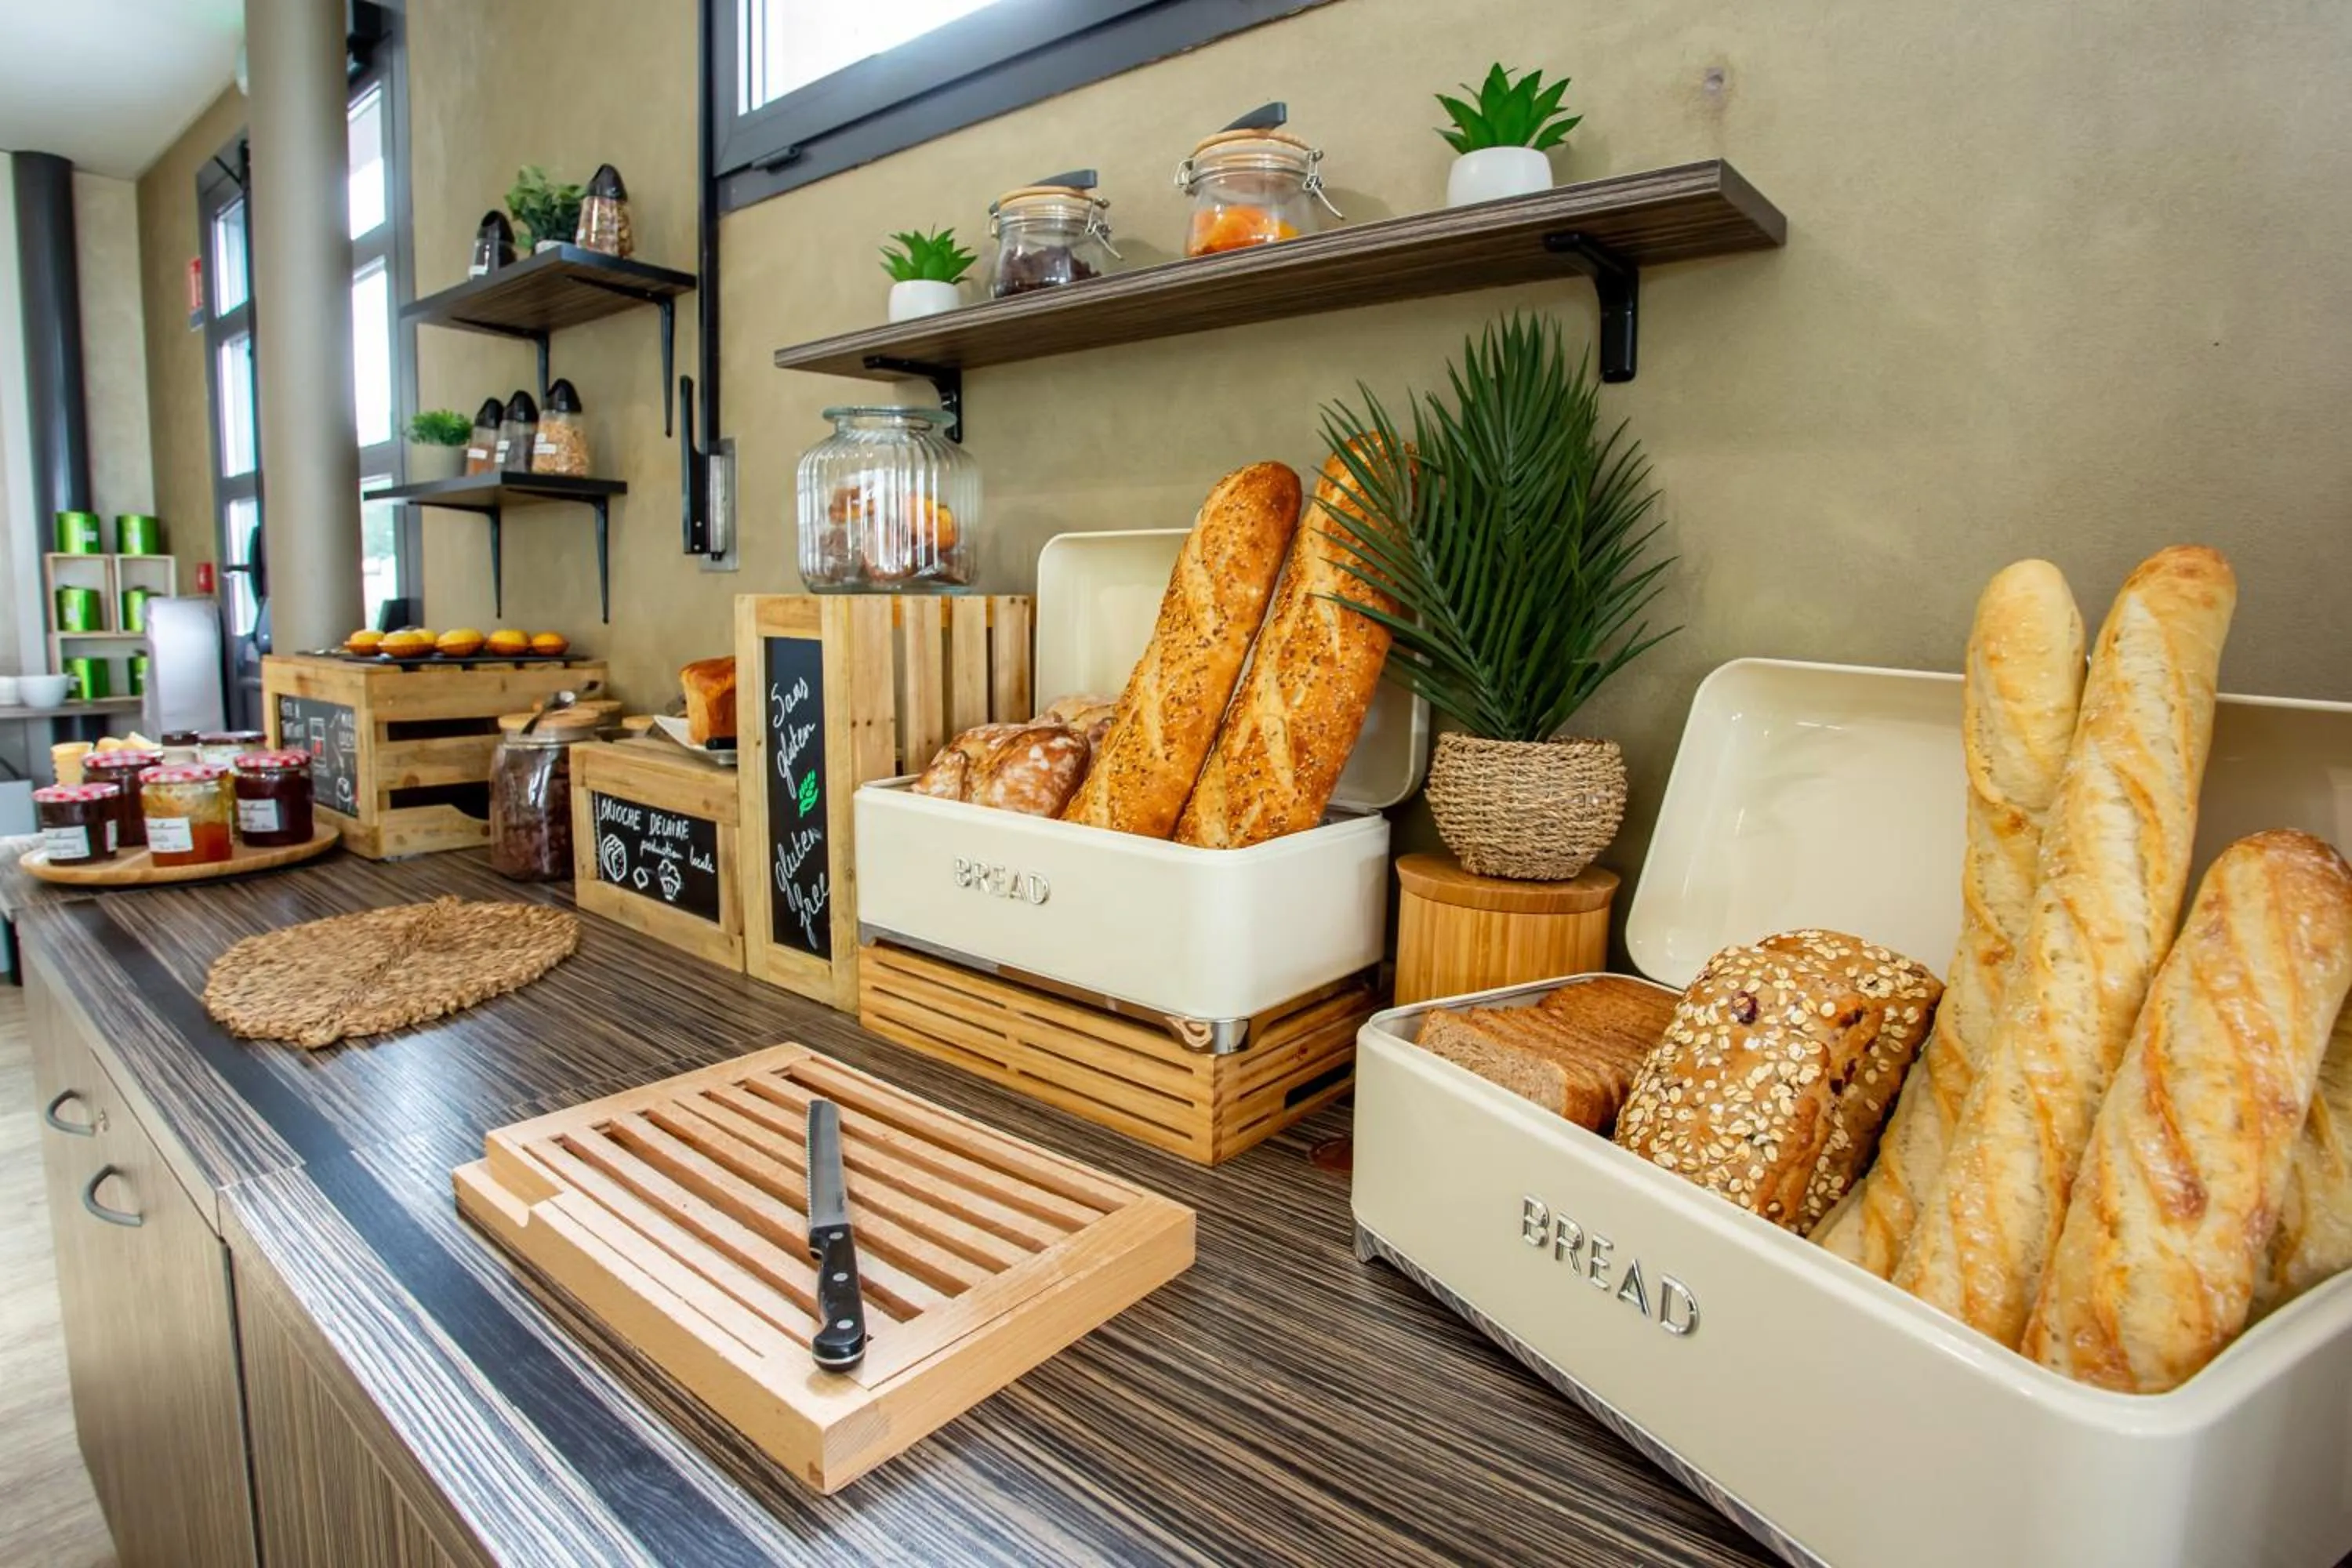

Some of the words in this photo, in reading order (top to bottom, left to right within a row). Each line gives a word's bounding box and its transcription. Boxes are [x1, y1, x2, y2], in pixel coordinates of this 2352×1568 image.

[771, 677, 808, 728] Sans
[777, 723, 815, 800] gluten
[775, 827, 822, 913] gluten
[955, 855, 1051, 905] BREAD
[1522, 1194, 1700, 1337] BREAD
